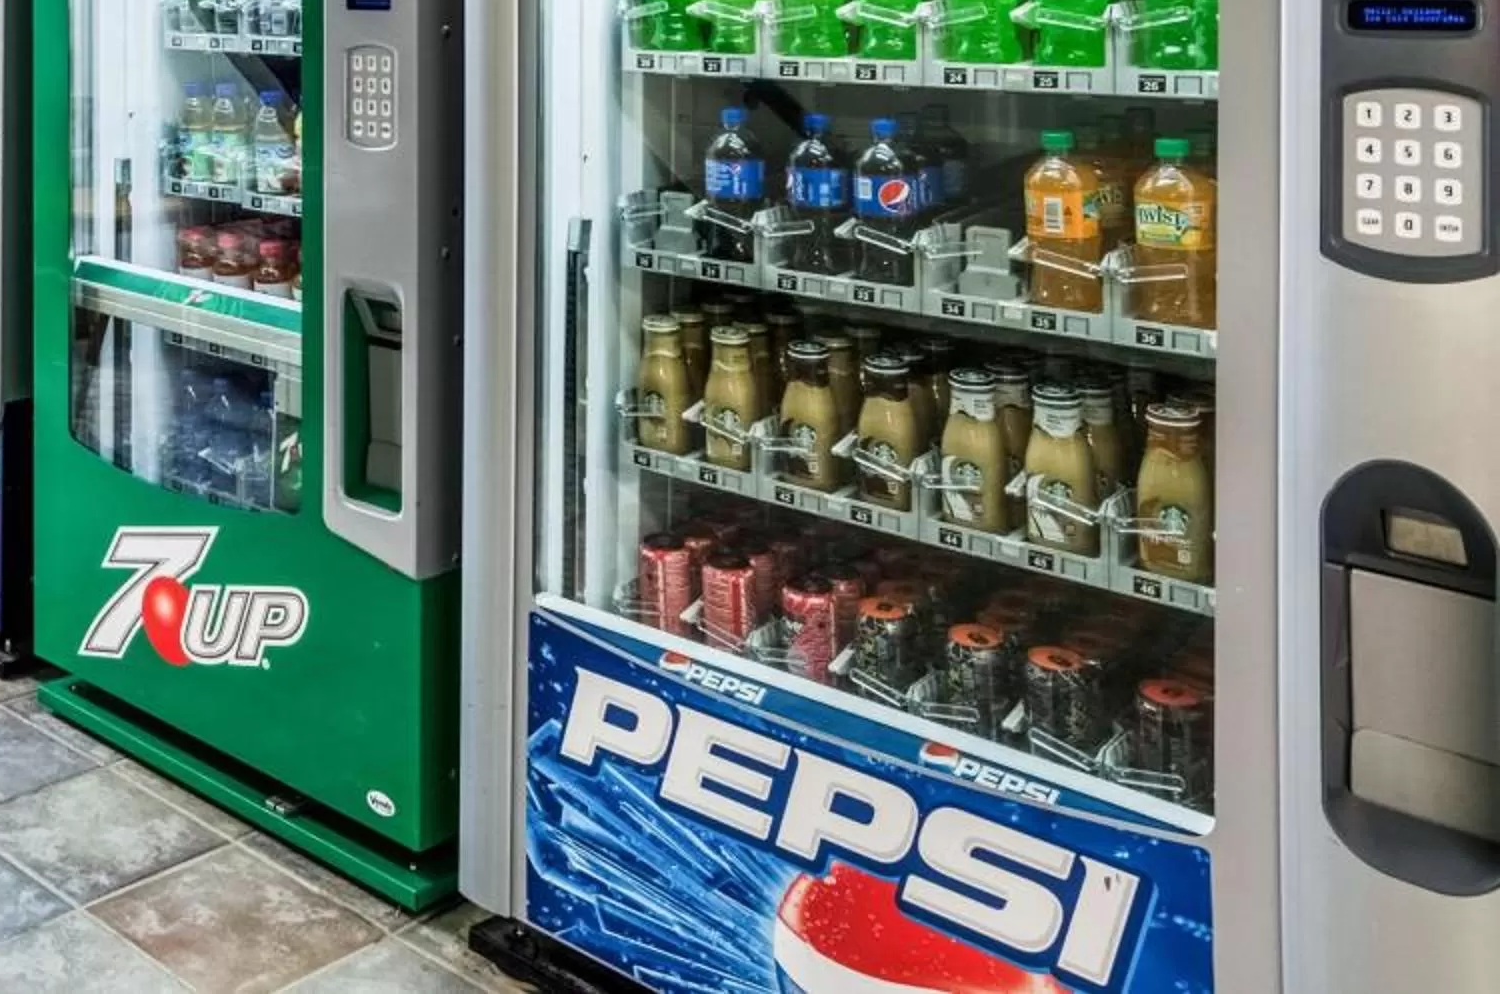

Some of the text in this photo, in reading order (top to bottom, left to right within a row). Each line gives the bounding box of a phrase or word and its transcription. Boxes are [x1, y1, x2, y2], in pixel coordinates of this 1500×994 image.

[1143, 81, 1160, 91] 26
[1365, 108, 1371, 119] 1
[1404, 109, 1412, 122] 2
[1444, 111, 1452, 123] 3
[1365, 144, 1373, 155] 4
[1404, 145, 1412, 158] 5
[1443, 148, 1453, 161] 6
[1365, 179, 1373, 191] 7
[1404, 182, 1413, 195] 8
[1443, 185, 1453, 197] 9
[685, 666, 768, 705] PEPSI
[953, 757, 1061, 806] PEPSI
[559, 667, 1141, 988] PEPSI
